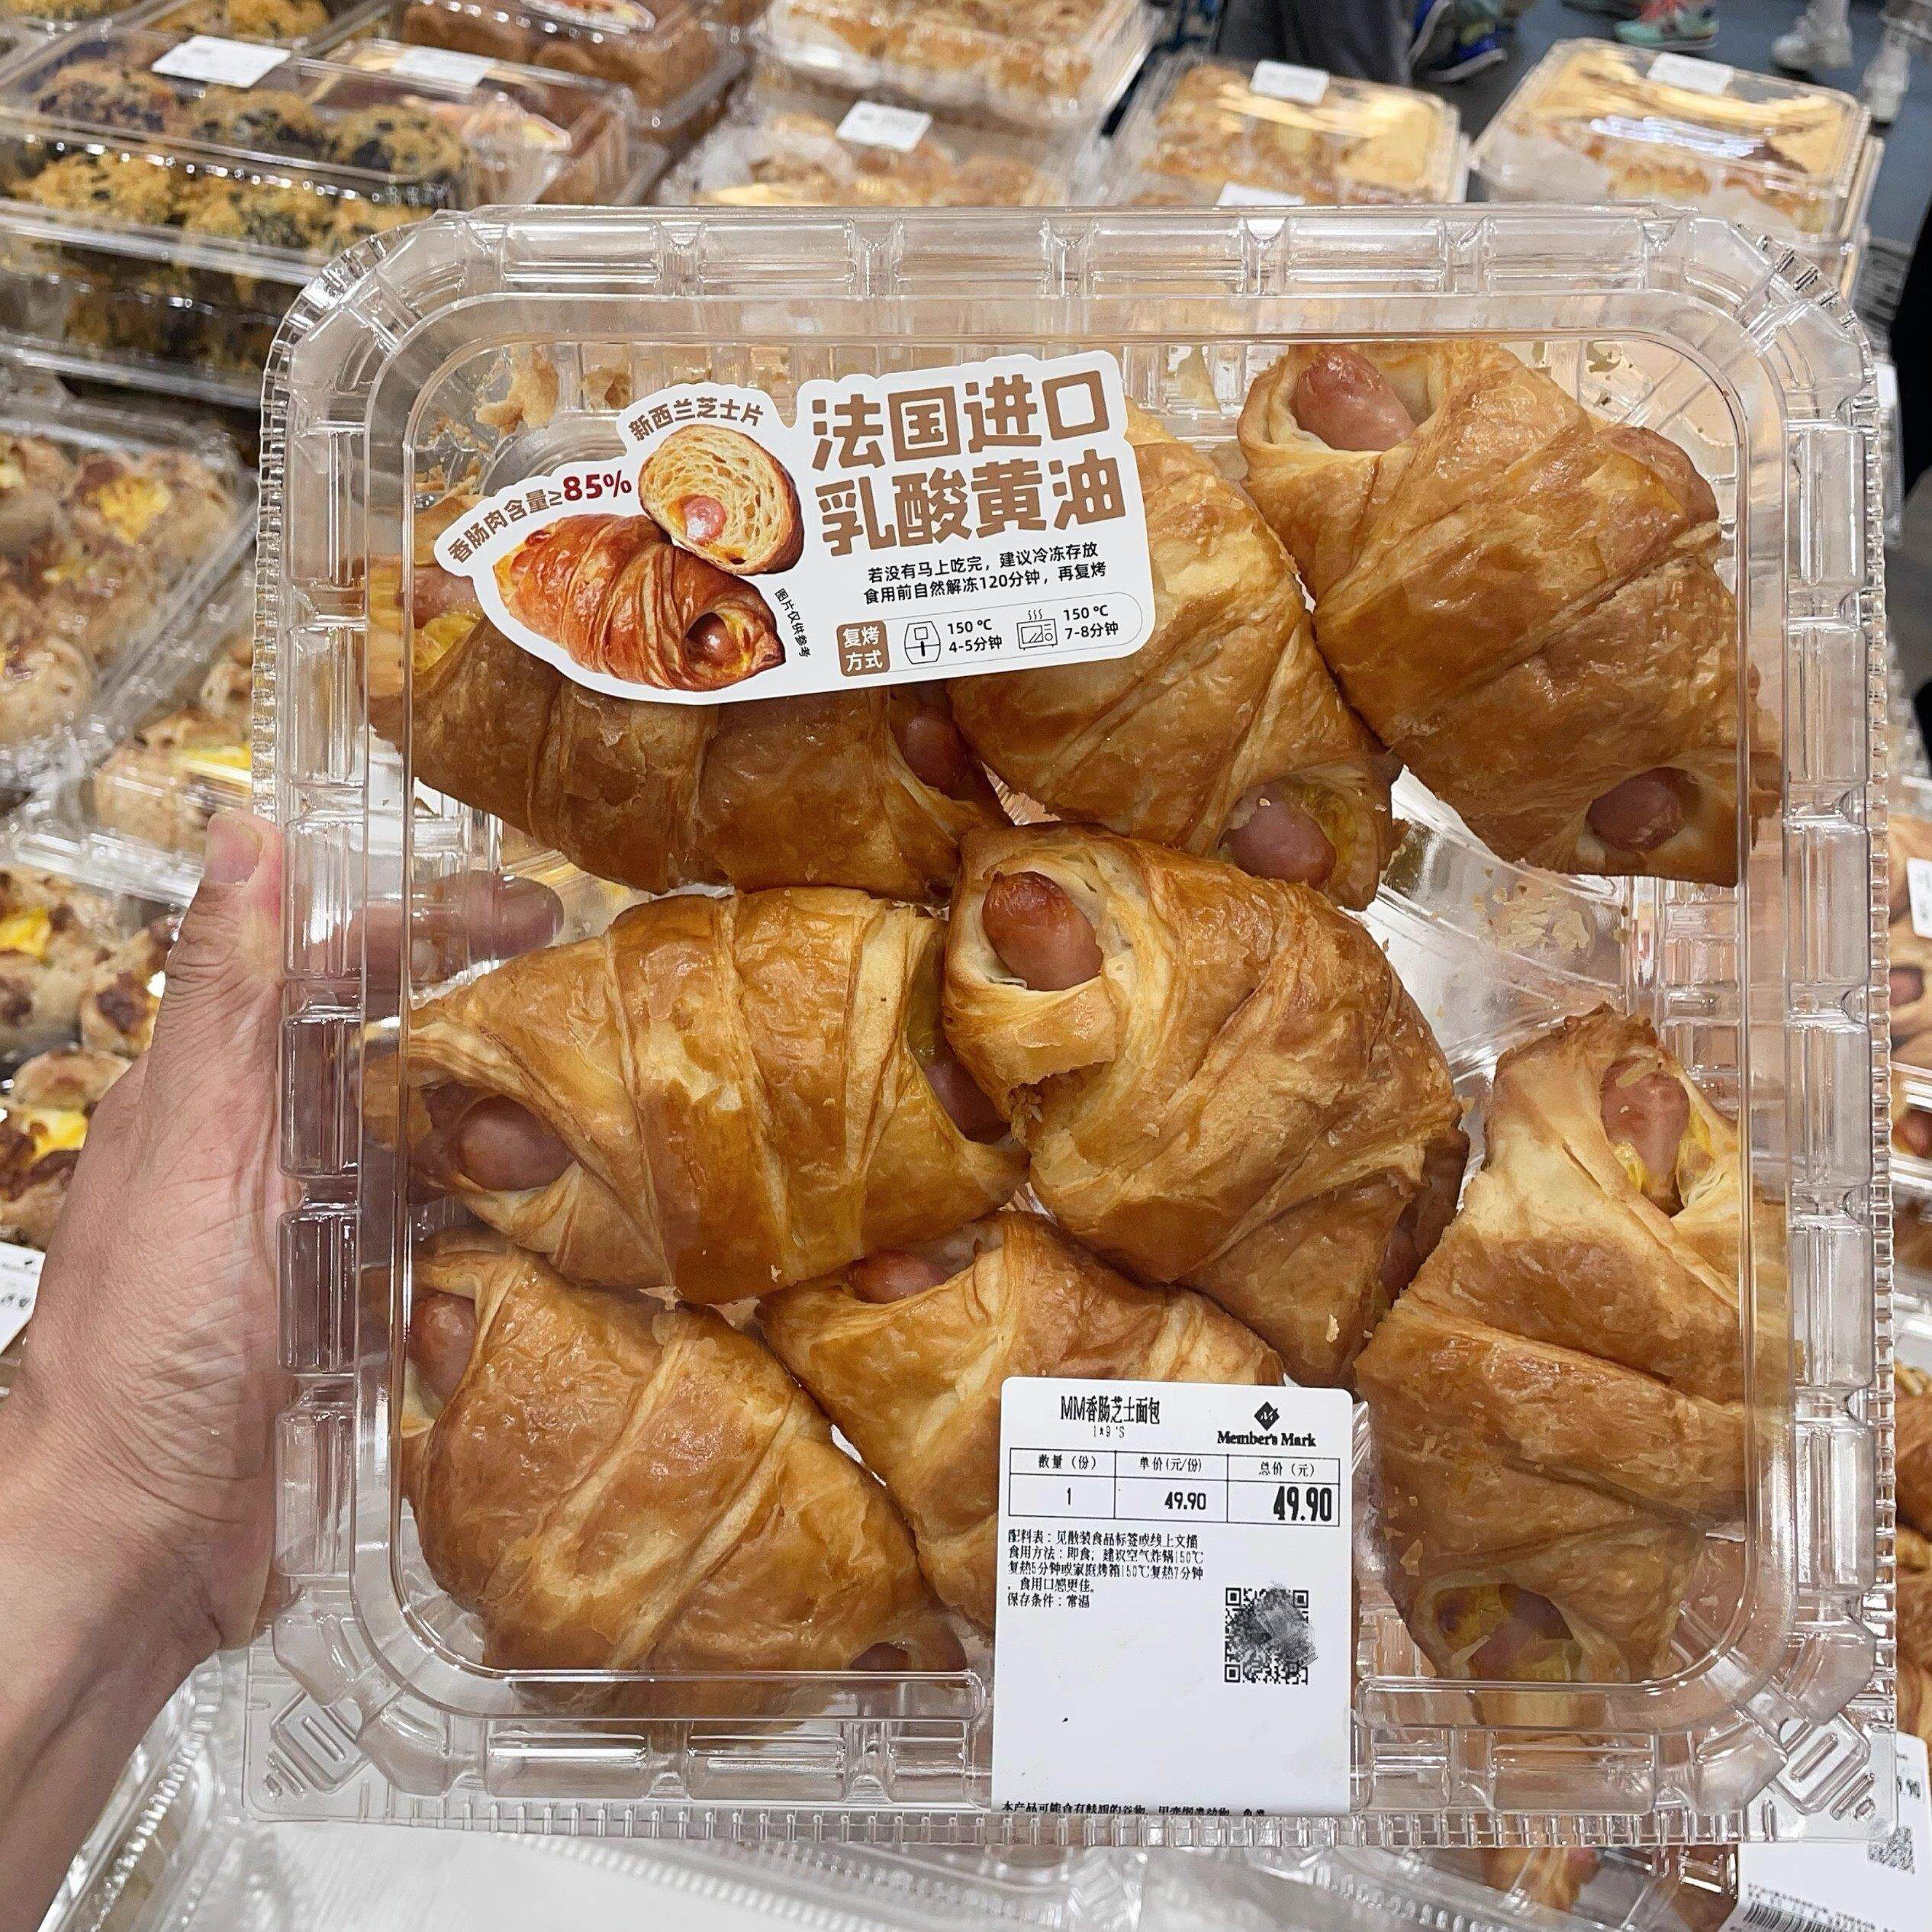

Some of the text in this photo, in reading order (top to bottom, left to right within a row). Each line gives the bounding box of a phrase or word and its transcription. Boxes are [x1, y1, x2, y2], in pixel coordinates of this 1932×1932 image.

[629, 397, 764, 440] 新西兰芝士片
[812, 370, 1110, 471] 法国进口
[815, 449, 1126, 556] 乳酸黄油
[868, 542, 1098, 584] 若没有马上吃完，建议冷冻存放
[864, 562, 1106, 605] 食用前自然解冻120分钟，再复烤
[774, 588, 811, 658] 图片仅供参考
[1063, 607, 1090, 621] 150
[843, 624, 880, 647] 复烤
[948, 621, 974, 635] 150
[1065, 622, 1119, 639] 7-8分钟
[948, 636, 1003, 653] 4-5分钟
[846, 649, 883, 671] 方式
[1061, 1396, 1160, 1425] MM香肠芝士面包
[1217, 1430, 1317, 1447] Member's Mark
[1067, 1487, 1071, 1505] 1
[1164, 1491, 1206, 1510] 49.90
[1274, 1486, 1332, 1521] 49.90
[1007, 1592, 1090, 1608] 保存条件：常温
